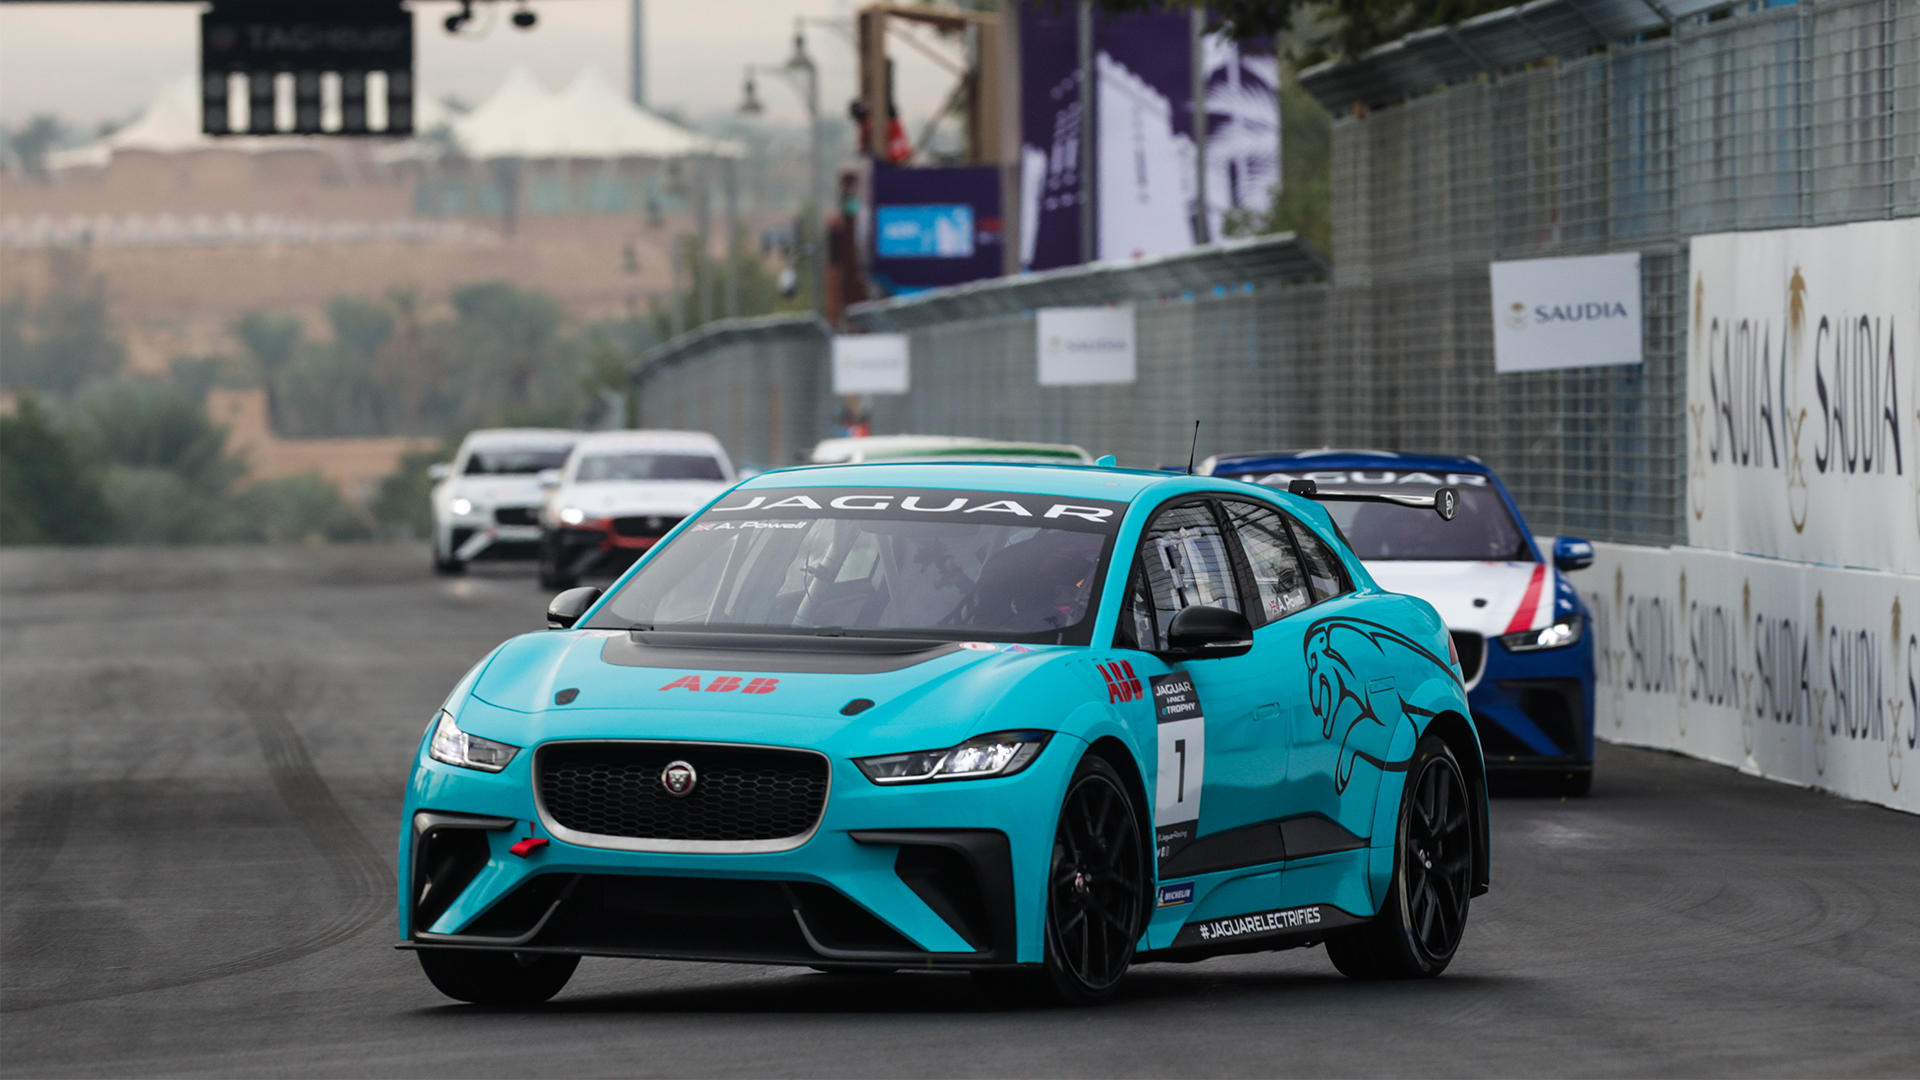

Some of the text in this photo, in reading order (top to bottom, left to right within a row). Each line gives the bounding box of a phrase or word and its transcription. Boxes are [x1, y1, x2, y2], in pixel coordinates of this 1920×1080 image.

[1534, 301, 1627, 324] SAUDIA
[1815, 314, 1903, 475] SAUDIA
[712, 495, 1114, 523] JAGUAR
[740, 521, 807, 529] Powell
[657, 675, 780, 694] ABB
[1096, 660, 1143, 704] ABB
[1156, 681, 1192, 697] JAGUAR
[1174, 739, 1186, 803] 1
[1200, 907, 1321, 940] #JAGUARELECTRIFIES
